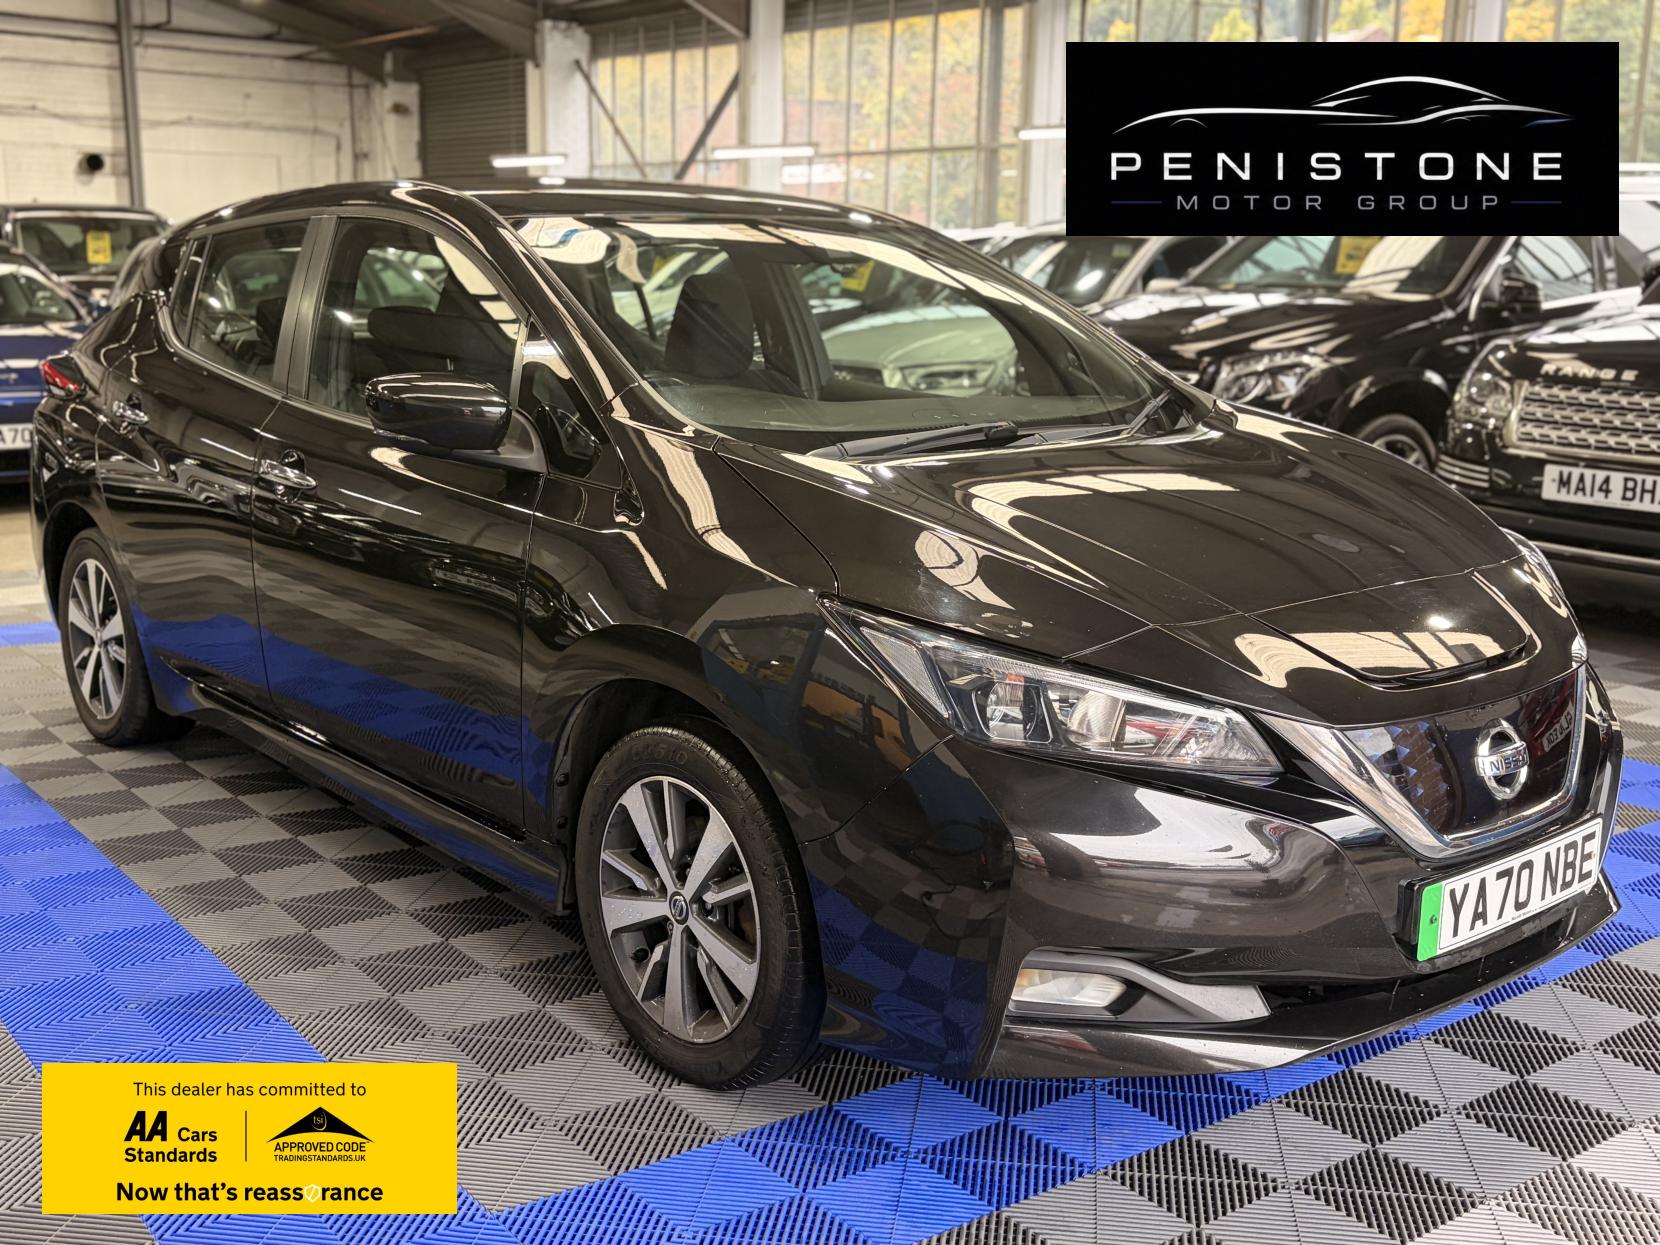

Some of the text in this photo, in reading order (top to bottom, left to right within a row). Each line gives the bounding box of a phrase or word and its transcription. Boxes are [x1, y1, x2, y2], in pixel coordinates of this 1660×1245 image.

[1540, 363, 1639, 381] RANGE
[1557, 471, 1660, 505] MA14 BH
[1449, 832, 1597, 938] YA70 NBE
